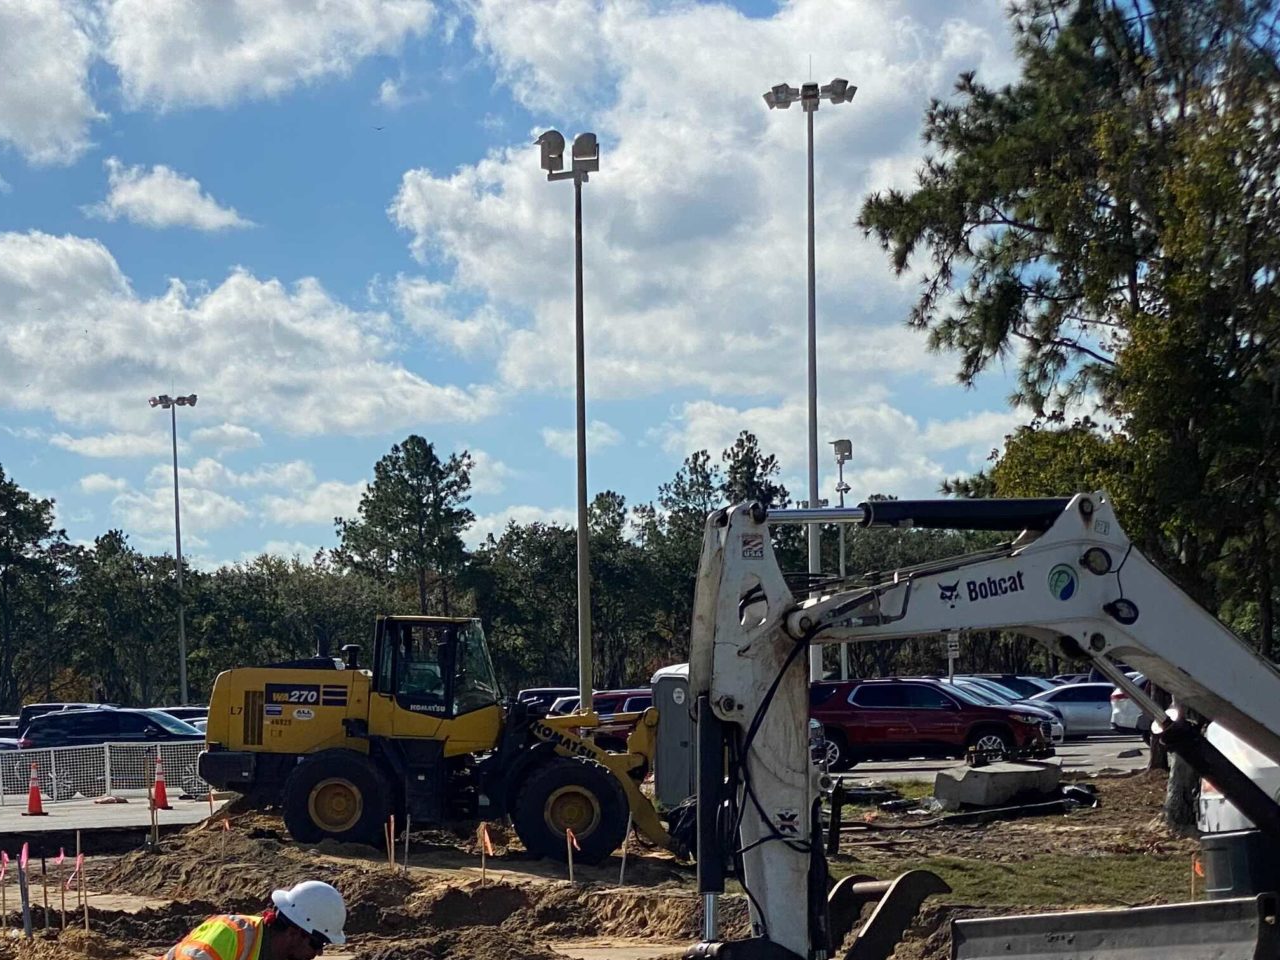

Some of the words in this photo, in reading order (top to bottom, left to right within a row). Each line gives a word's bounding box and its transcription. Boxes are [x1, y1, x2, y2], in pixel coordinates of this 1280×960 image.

[966, 570, 1024, 602] Bobcat
[410, 704, 446, 713] KOMATSU
[532, 721, 598, 760] KOMATSU
